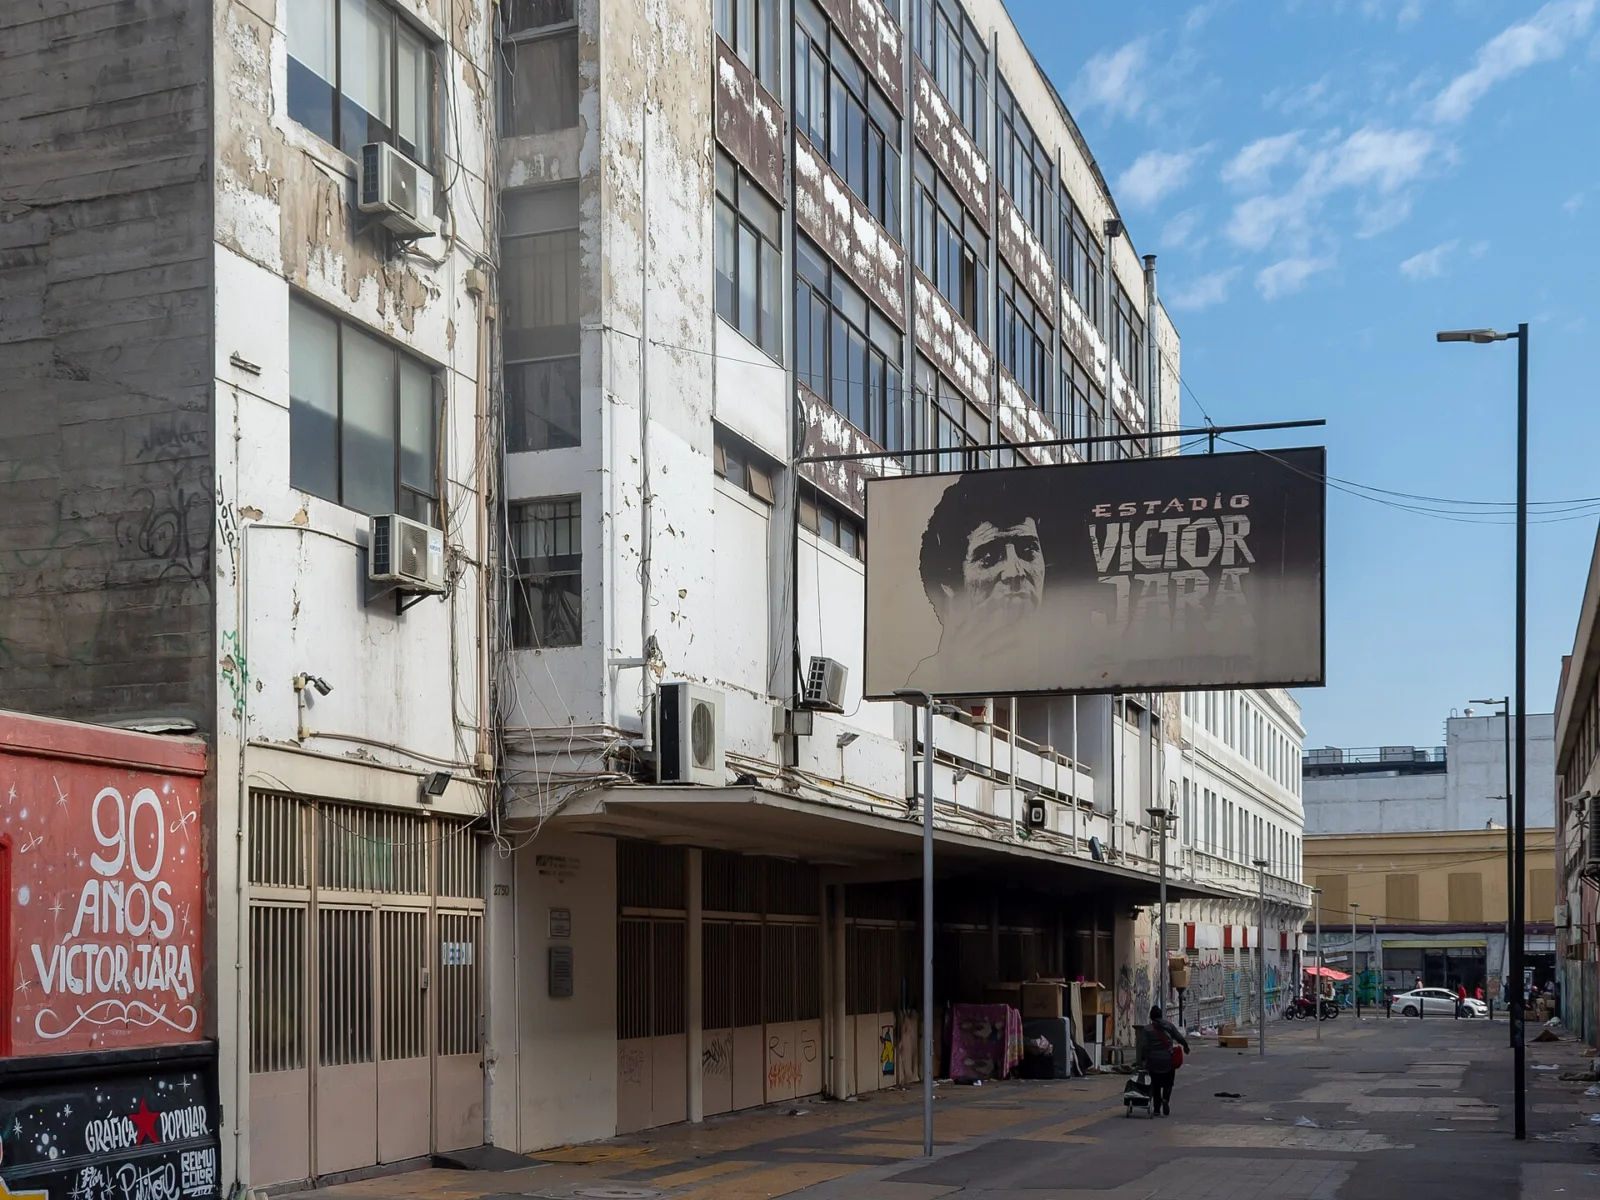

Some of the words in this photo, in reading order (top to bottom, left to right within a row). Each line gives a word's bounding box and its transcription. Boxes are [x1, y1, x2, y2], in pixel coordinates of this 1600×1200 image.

[1088, 514, 1256, 573] VICTOR
[90, 786, 165, 882] 90
[30, 932, 132, 995] VÍCTOR
[134, 944, 195, 1000] JARA
[85, 1110, 138, 1153] GRÁFICA
[160, 1105, 209, 1143] POPULAR
